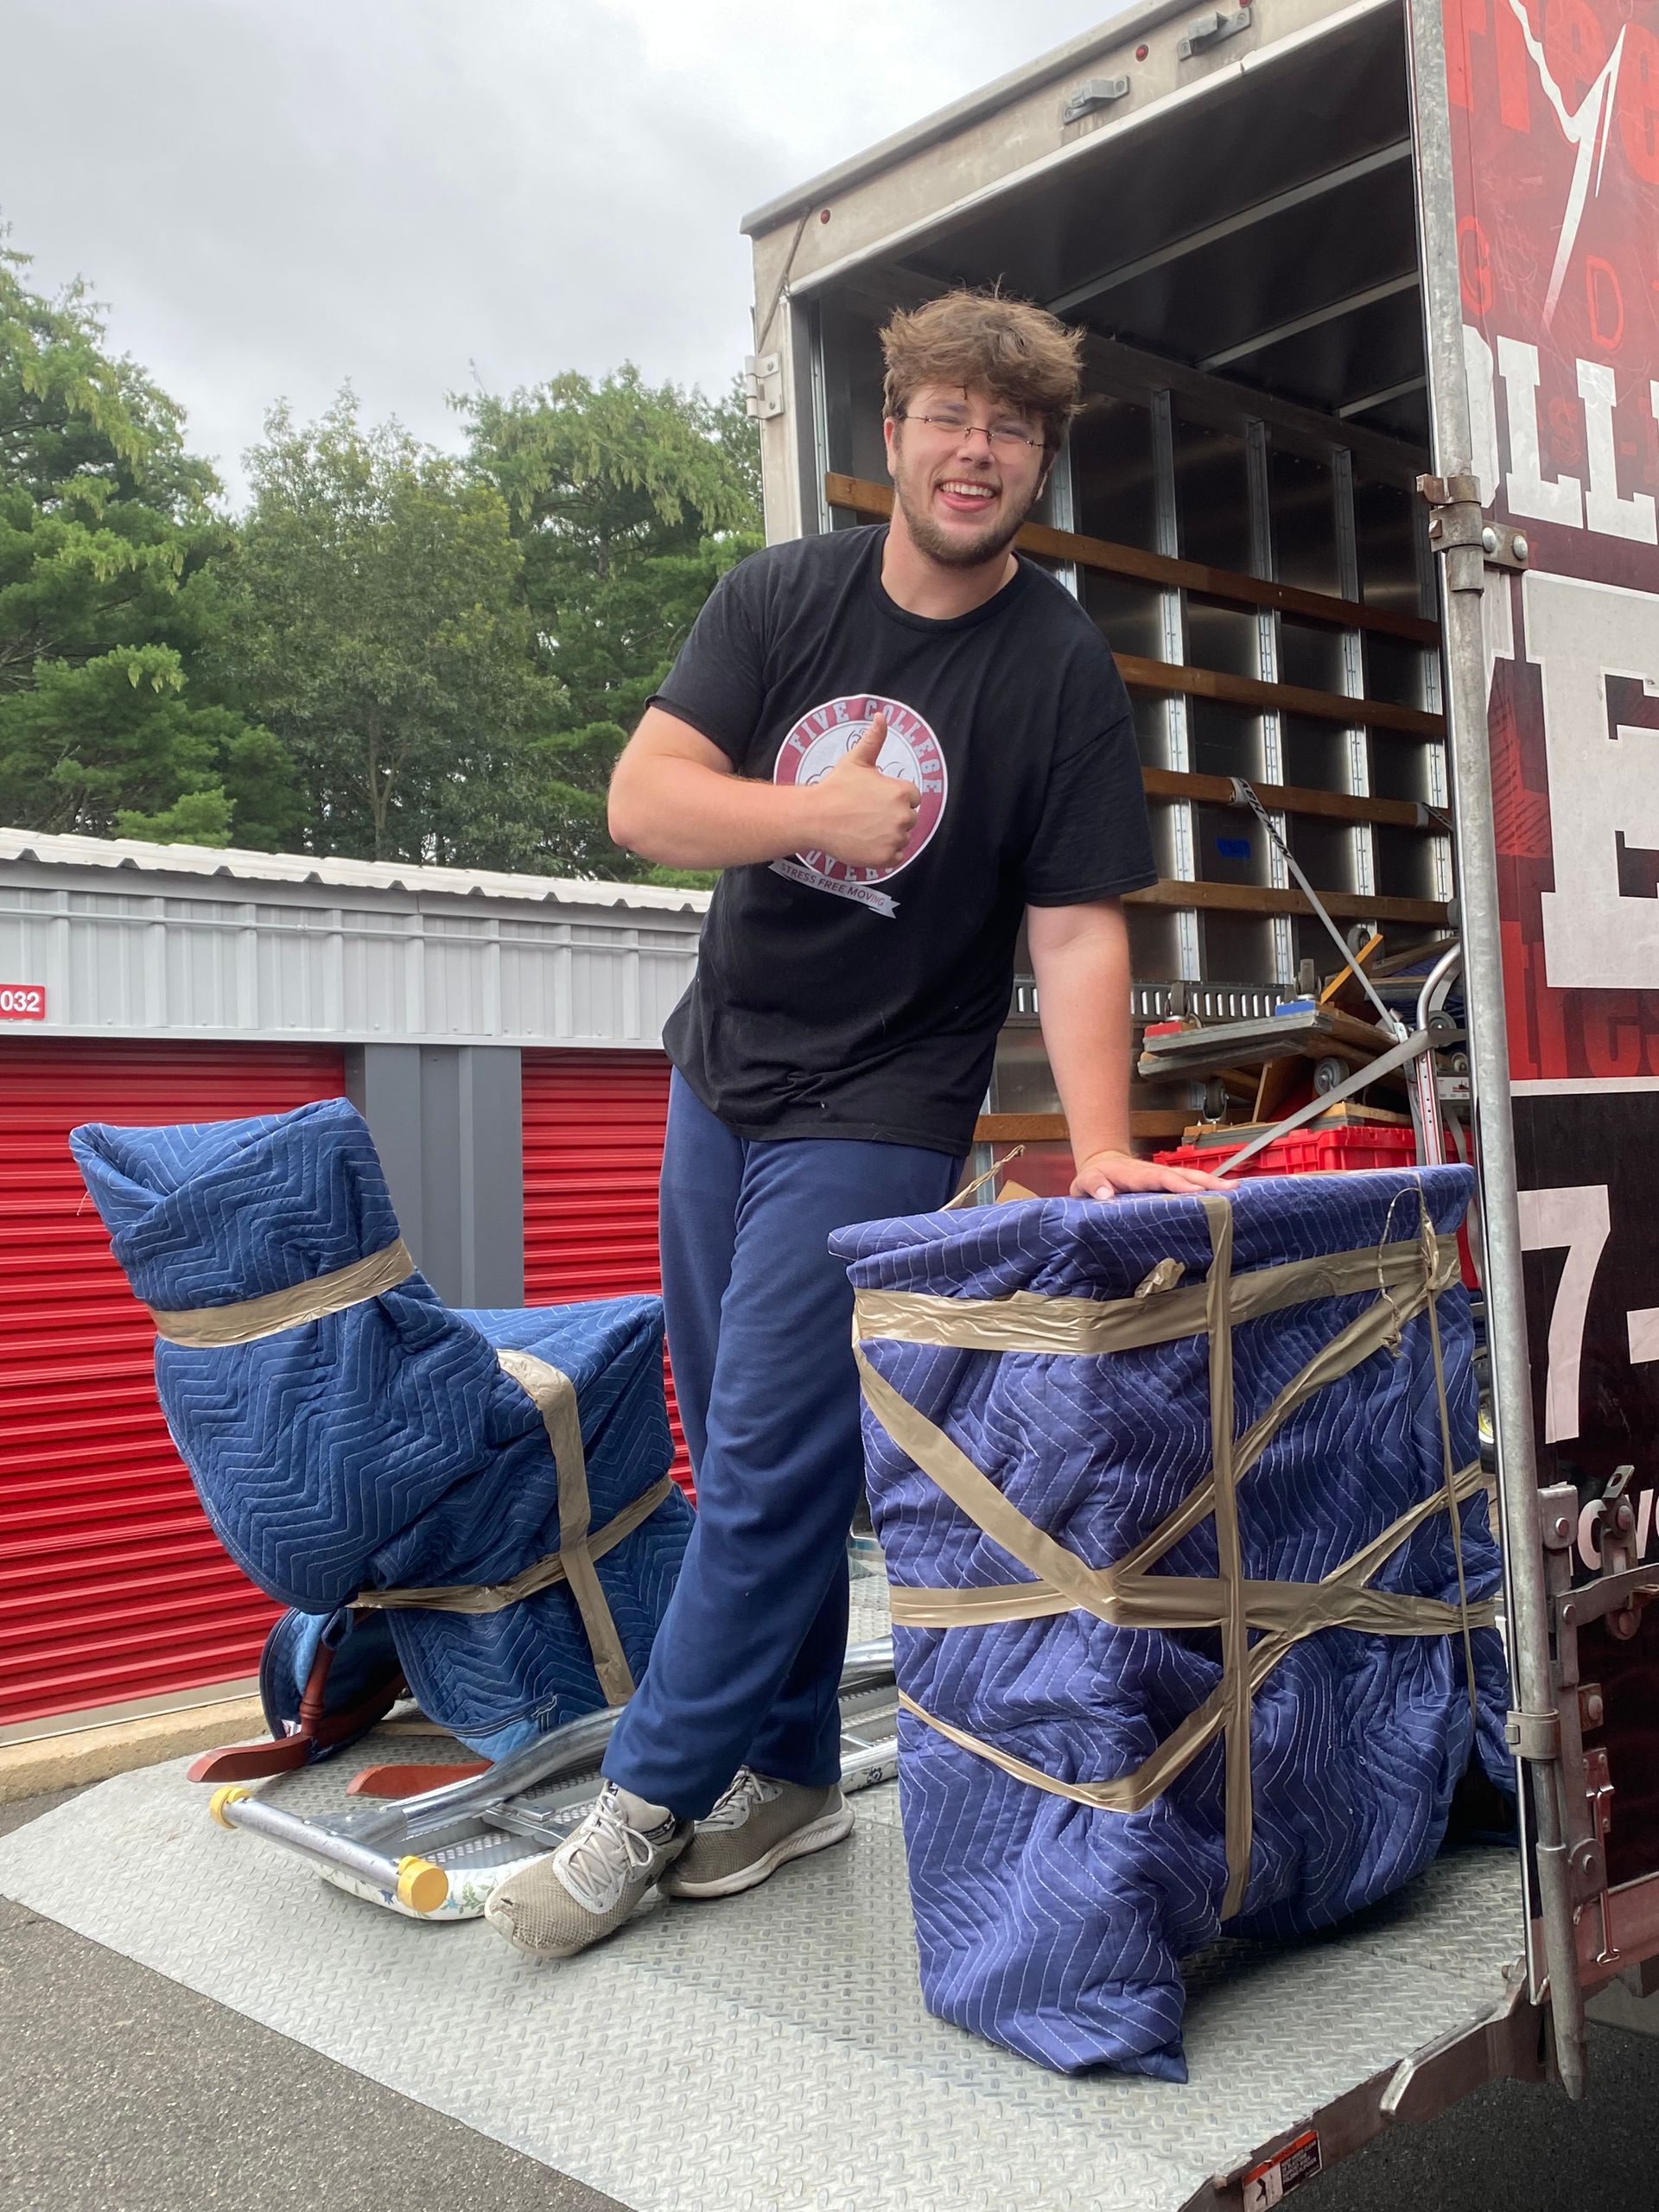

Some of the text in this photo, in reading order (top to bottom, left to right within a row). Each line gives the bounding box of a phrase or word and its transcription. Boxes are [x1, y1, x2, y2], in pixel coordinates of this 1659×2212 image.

[788, 700, 943, 792] FIVE COLLEGE
[781, 863, 886, 906] STRESS FREE MOVING
[0, 990, 40, 1012] 032
